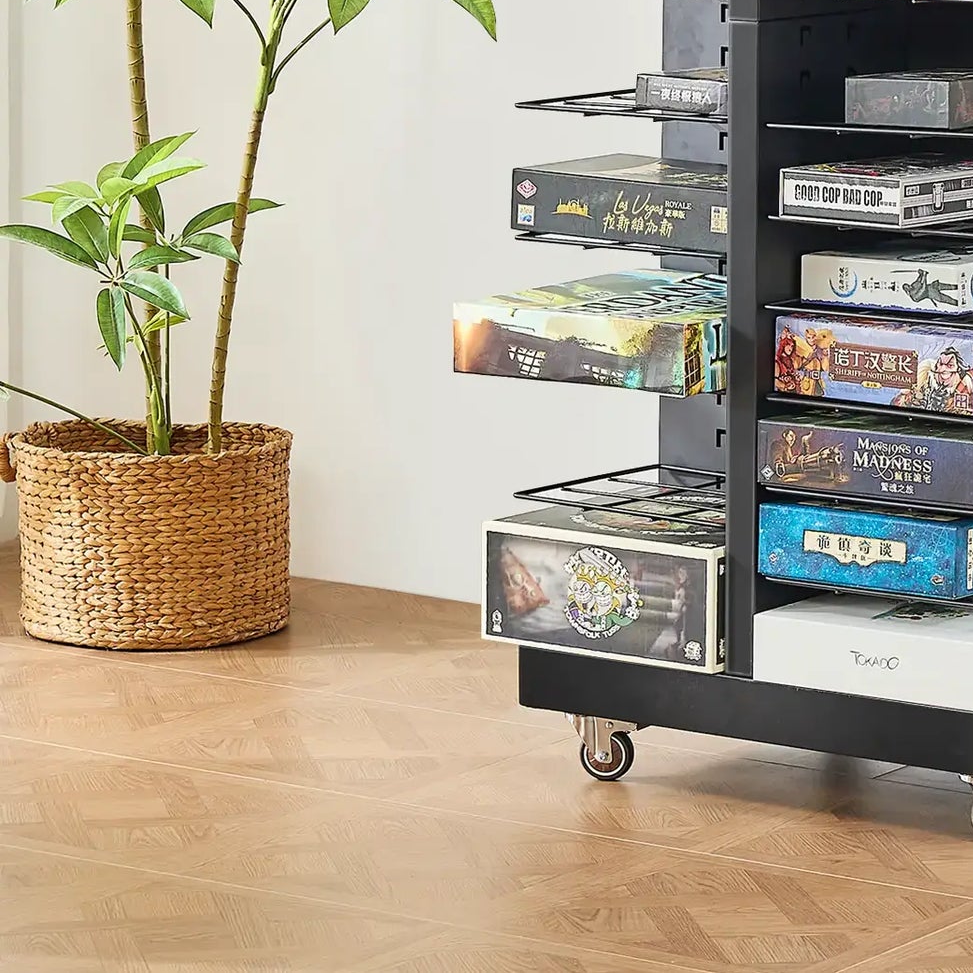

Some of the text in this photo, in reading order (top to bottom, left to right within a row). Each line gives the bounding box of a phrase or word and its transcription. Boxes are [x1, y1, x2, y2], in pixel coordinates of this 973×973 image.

[614, 190, 663, 220] Las Vegas
[664, 200, 692, 210] ROYALE
[794, 184, 883, 208] GOOD COP BAD COP
[602, 213, 673, 238] 拉斯維加斯
[833, 347, 914, 374] 诺丁汉警长
[834, 367, 862, 378] SHERIFF
[867, 370, 912, 384] NOTTINGHAM
[857, 436, 929, 456] MANSIONS OF
[853, 450, 932, 473] MADNESS
[816, 534, 893, 558] 诡镇奇谈
